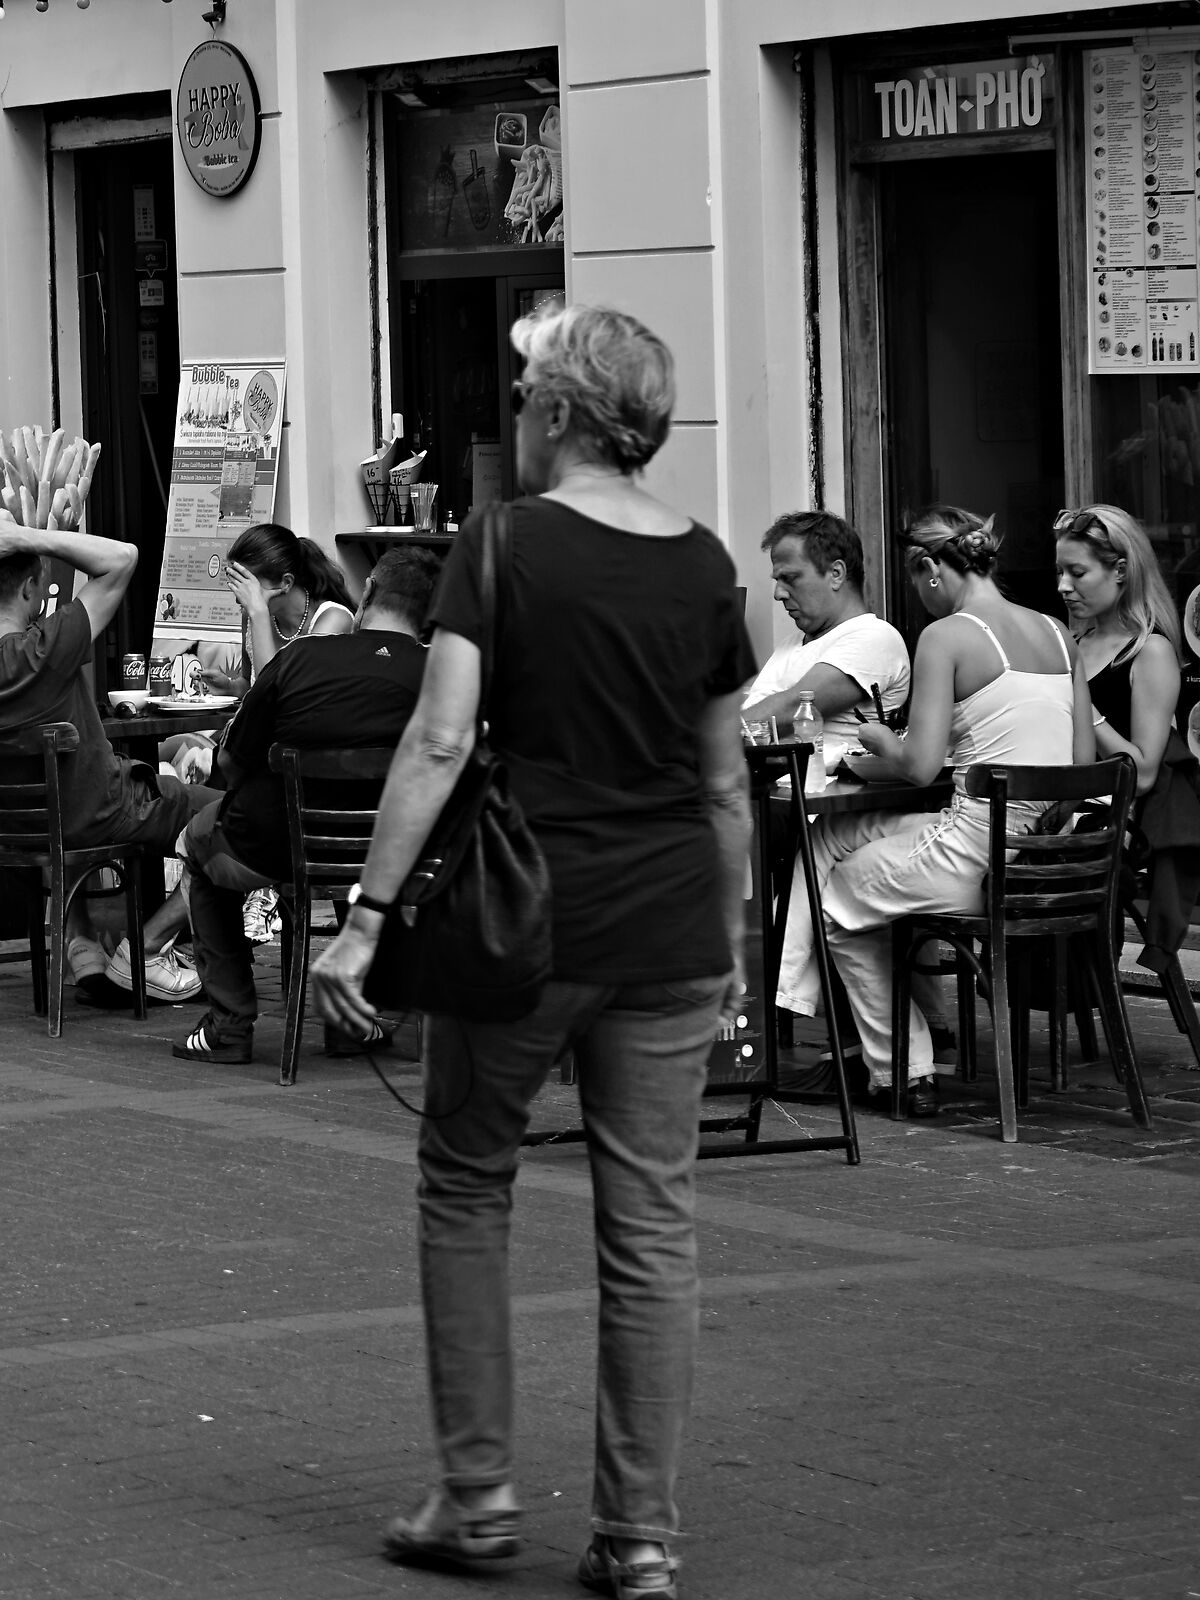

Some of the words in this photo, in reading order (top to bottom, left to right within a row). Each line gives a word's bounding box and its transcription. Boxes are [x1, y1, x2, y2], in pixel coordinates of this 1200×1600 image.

[188, 82, 240, 112] HAPPY
[187, 109, 241, 148] Boba
[191, 365, 226, 385] Bubble
[225, 375, 240, 389] Tea
[253, 382, 274, 411] HAPPY
